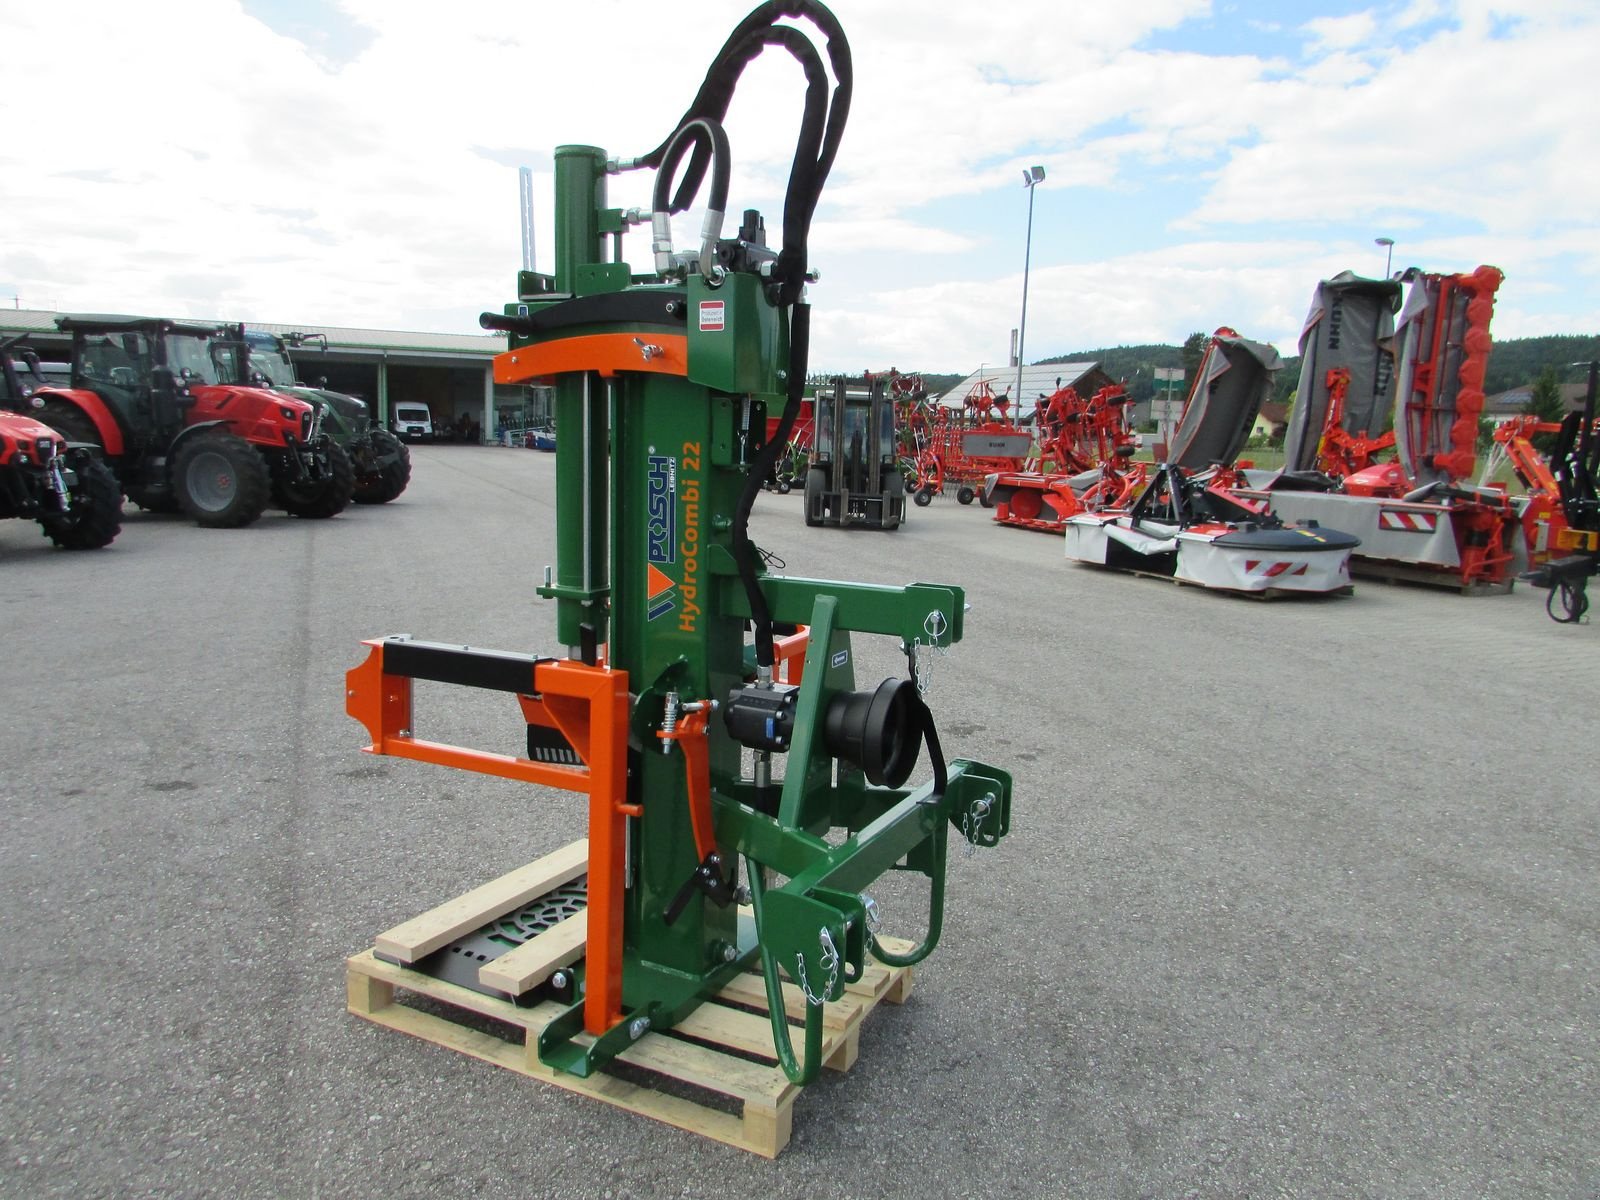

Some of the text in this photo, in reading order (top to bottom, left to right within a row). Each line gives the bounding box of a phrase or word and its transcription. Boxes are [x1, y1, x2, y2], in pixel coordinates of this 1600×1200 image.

[1328, 297, 1342, 350] KUHN
[648, 456, 668, 563] POSCH
[679, 442, 700, 632] HydroCombi 22
